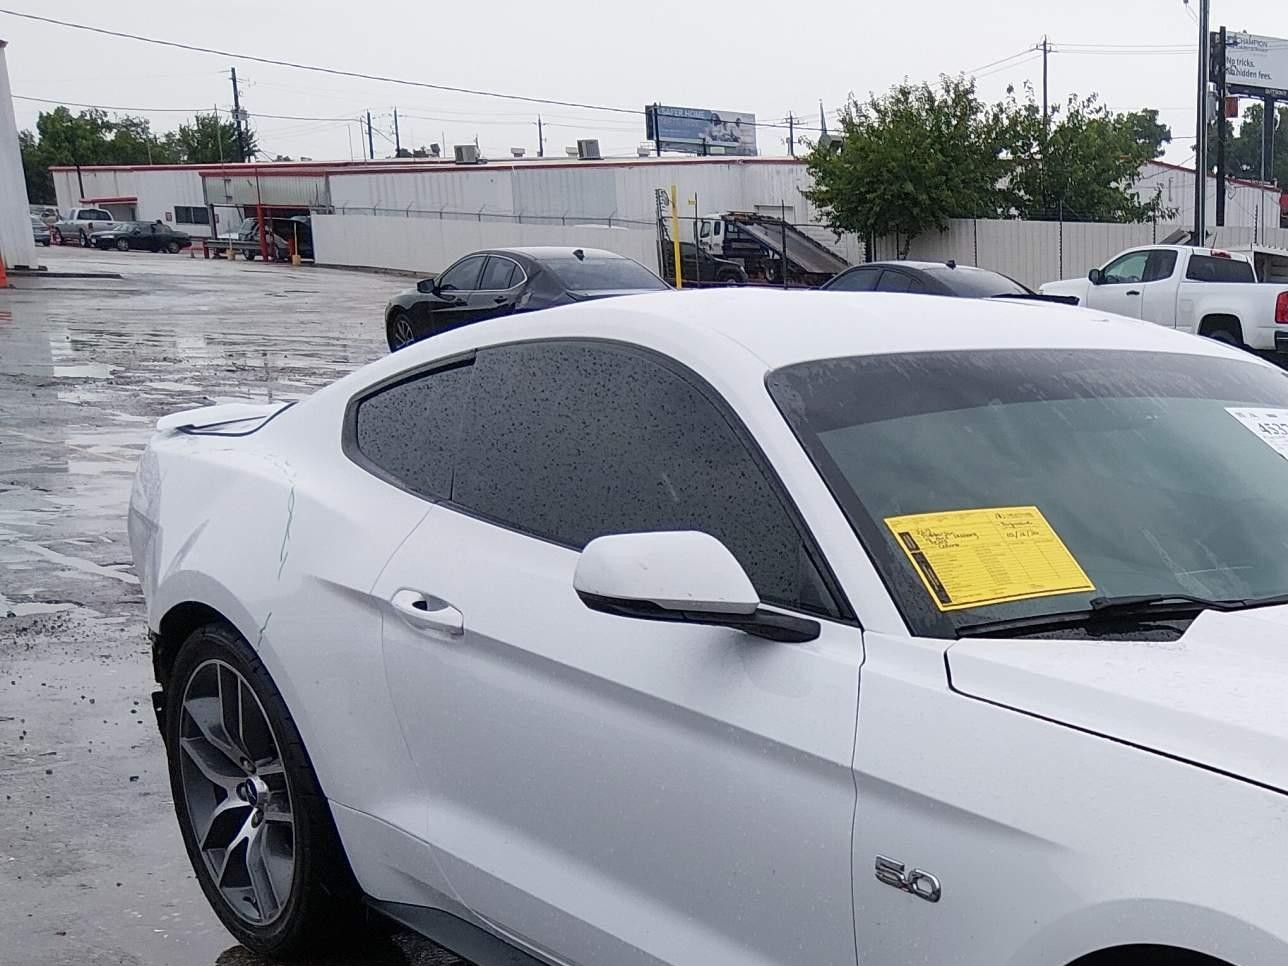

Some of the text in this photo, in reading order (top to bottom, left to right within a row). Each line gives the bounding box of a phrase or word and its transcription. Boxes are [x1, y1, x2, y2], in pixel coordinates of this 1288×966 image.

[1226, 55, 1256, 68] No tricks.
[1236, 67, 1257, 78] hidden
[1258, 71, 1272, 80] fees.
[684, 110, 705, 119] HOME
[875, 854, 941, 903] 5.0
